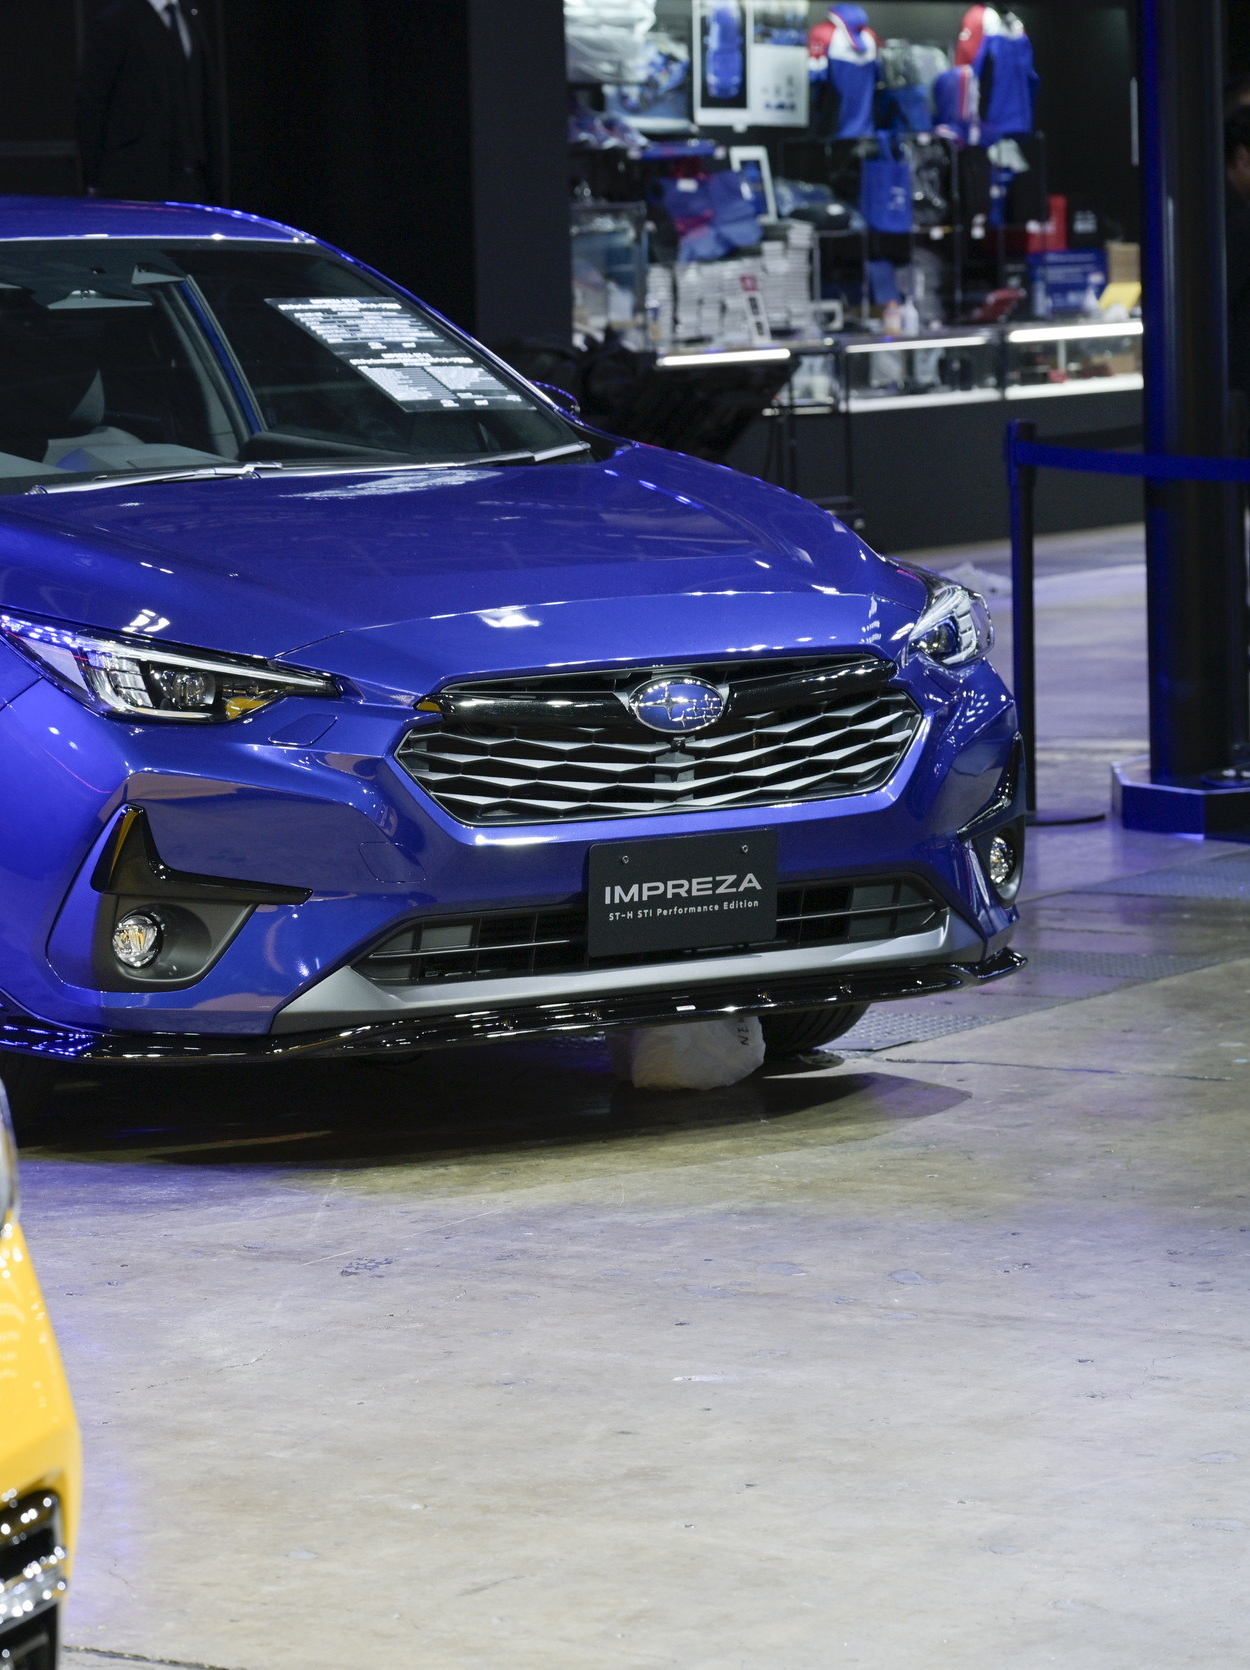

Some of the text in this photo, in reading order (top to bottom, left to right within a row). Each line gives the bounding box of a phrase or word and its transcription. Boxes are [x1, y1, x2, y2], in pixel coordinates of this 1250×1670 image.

[604, 873, 763, 905] IMPREZA
[608, 899, 760, 921] ST-H STI Performance Edition
